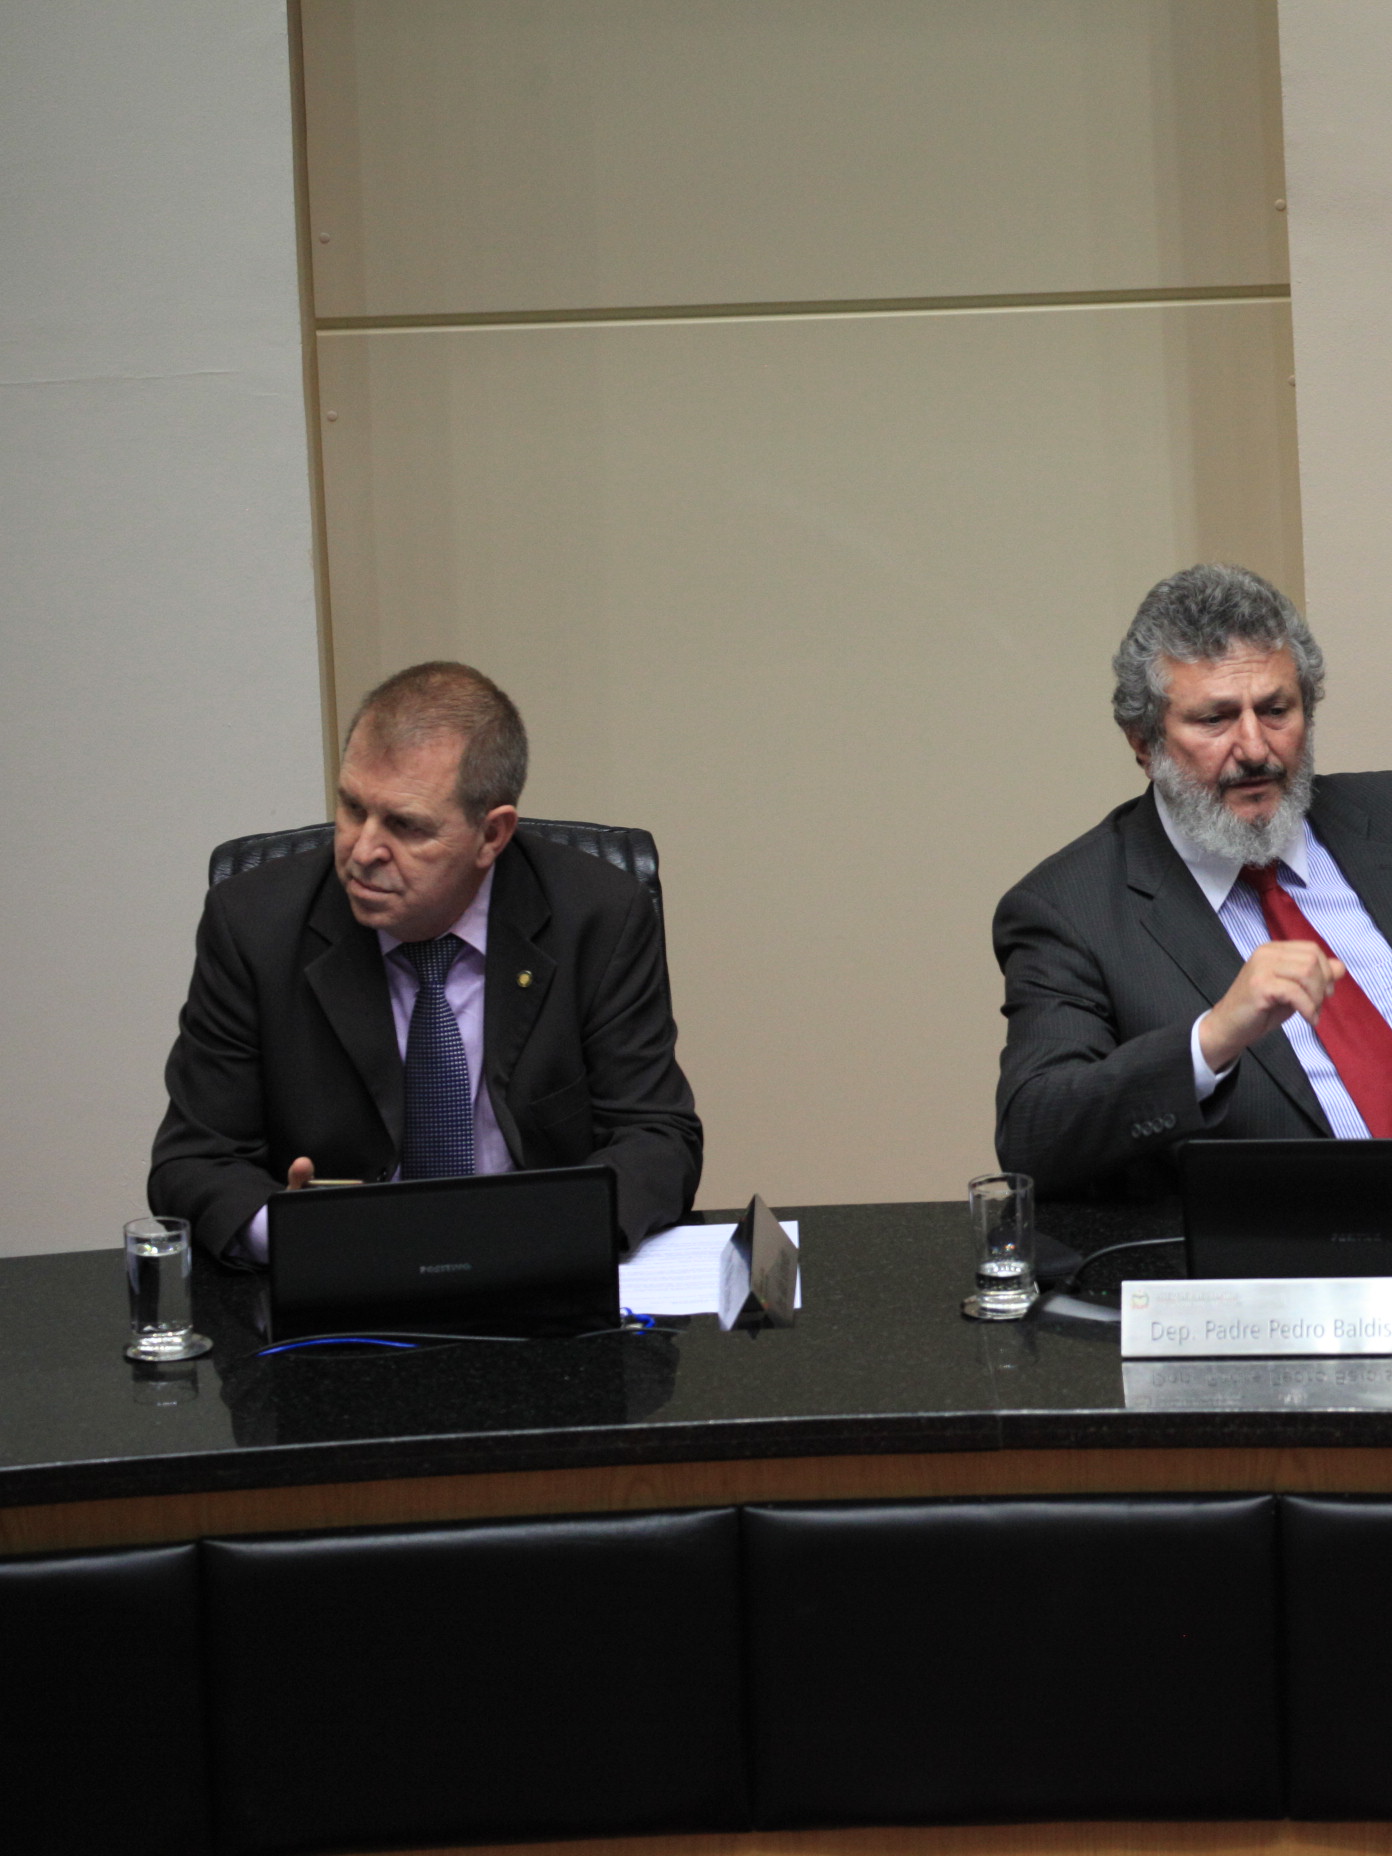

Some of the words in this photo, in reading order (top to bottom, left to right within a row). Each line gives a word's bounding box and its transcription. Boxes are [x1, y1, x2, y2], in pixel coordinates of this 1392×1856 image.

[1151, 1320, 1196, 1345] Dep.
[1205, 1319, 1261, 1341] Padre
[1270, 1317, 1325, 1340] Pedro
